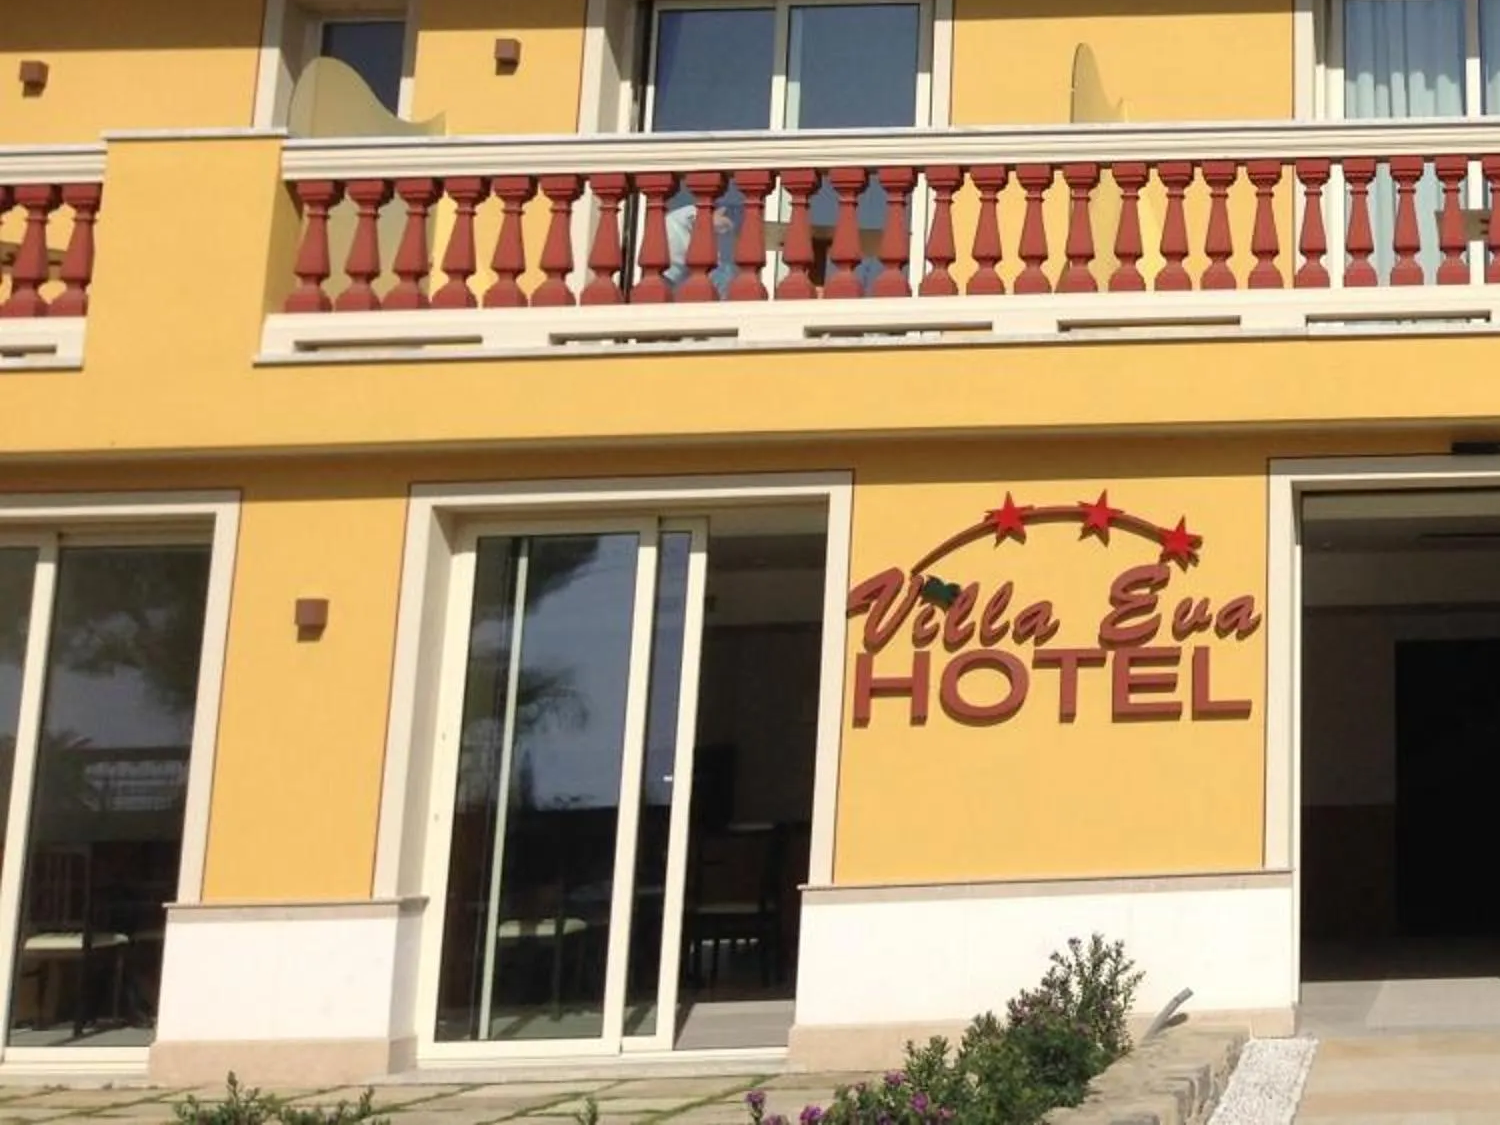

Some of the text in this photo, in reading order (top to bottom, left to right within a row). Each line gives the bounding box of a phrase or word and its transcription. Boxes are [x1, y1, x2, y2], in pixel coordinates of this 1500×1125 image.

[847, 563, 1261, 652] Villa Eva
[852, 646, 1253, 727] HOTEL
